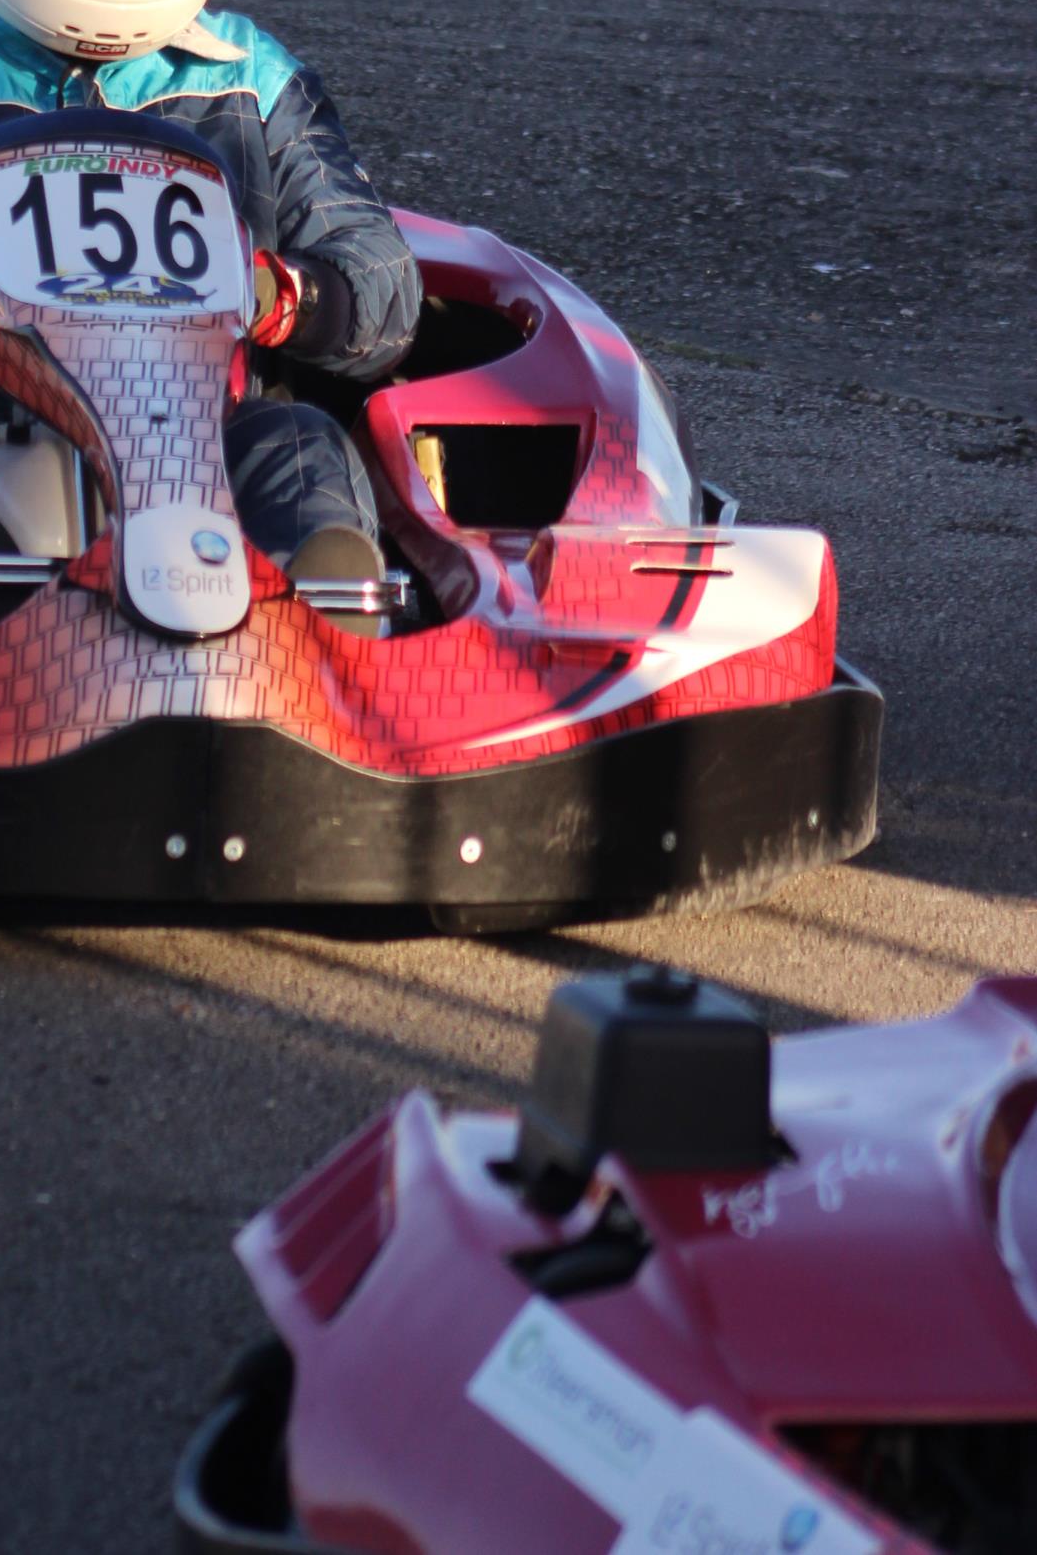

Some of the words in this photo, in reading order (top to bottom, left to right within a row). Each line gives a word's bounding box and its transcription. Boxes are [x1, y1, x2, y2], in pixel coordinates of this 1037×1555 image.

[23, 156, 182, 181] EUROINDY
[10, 174, 210, 283] 156
[61, 274, 162, 295] 24
[166, 566, 234, 597] Spirit
